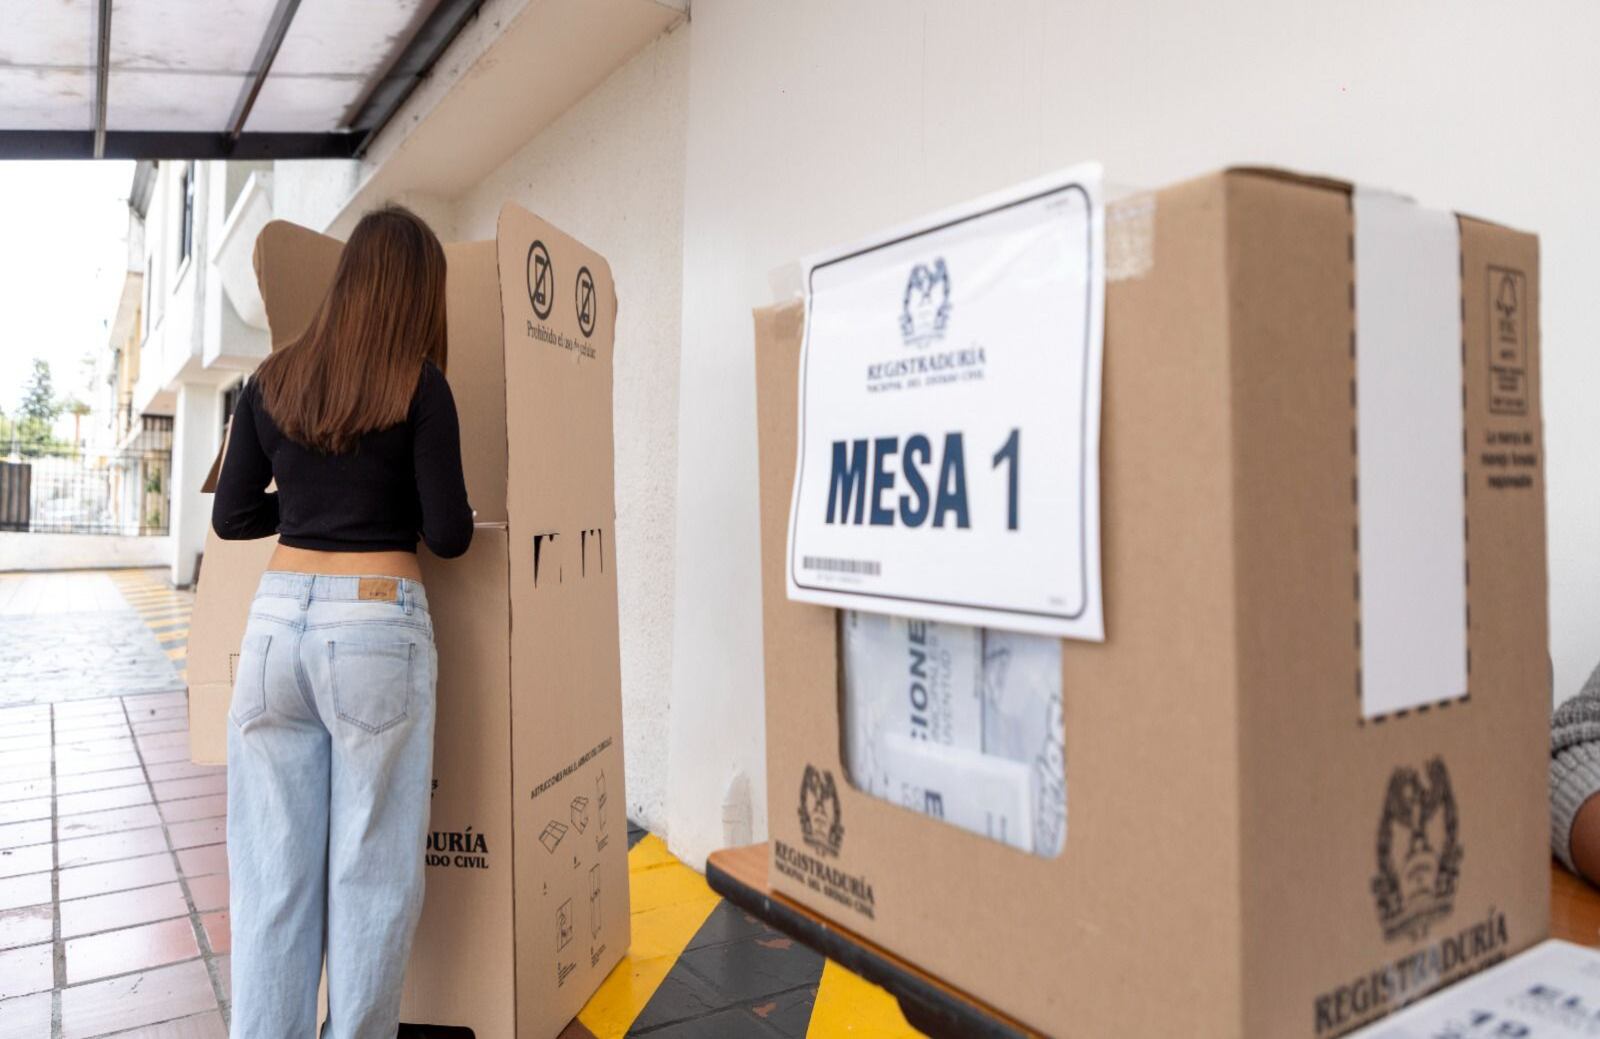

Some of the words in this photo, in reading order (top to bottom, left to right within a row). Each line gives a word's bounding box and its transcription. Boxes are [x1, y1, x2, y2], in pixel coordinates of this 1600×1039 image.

[825, 432, 971, 529] MESA
[992, 427, 1019, 531] 1
[454, 855, 489, 869] CIVIL
[775, 840, 875, 906] REGISTRADURÍA
[1313, 904, 1509, 1036] REGISTRADURÍA
